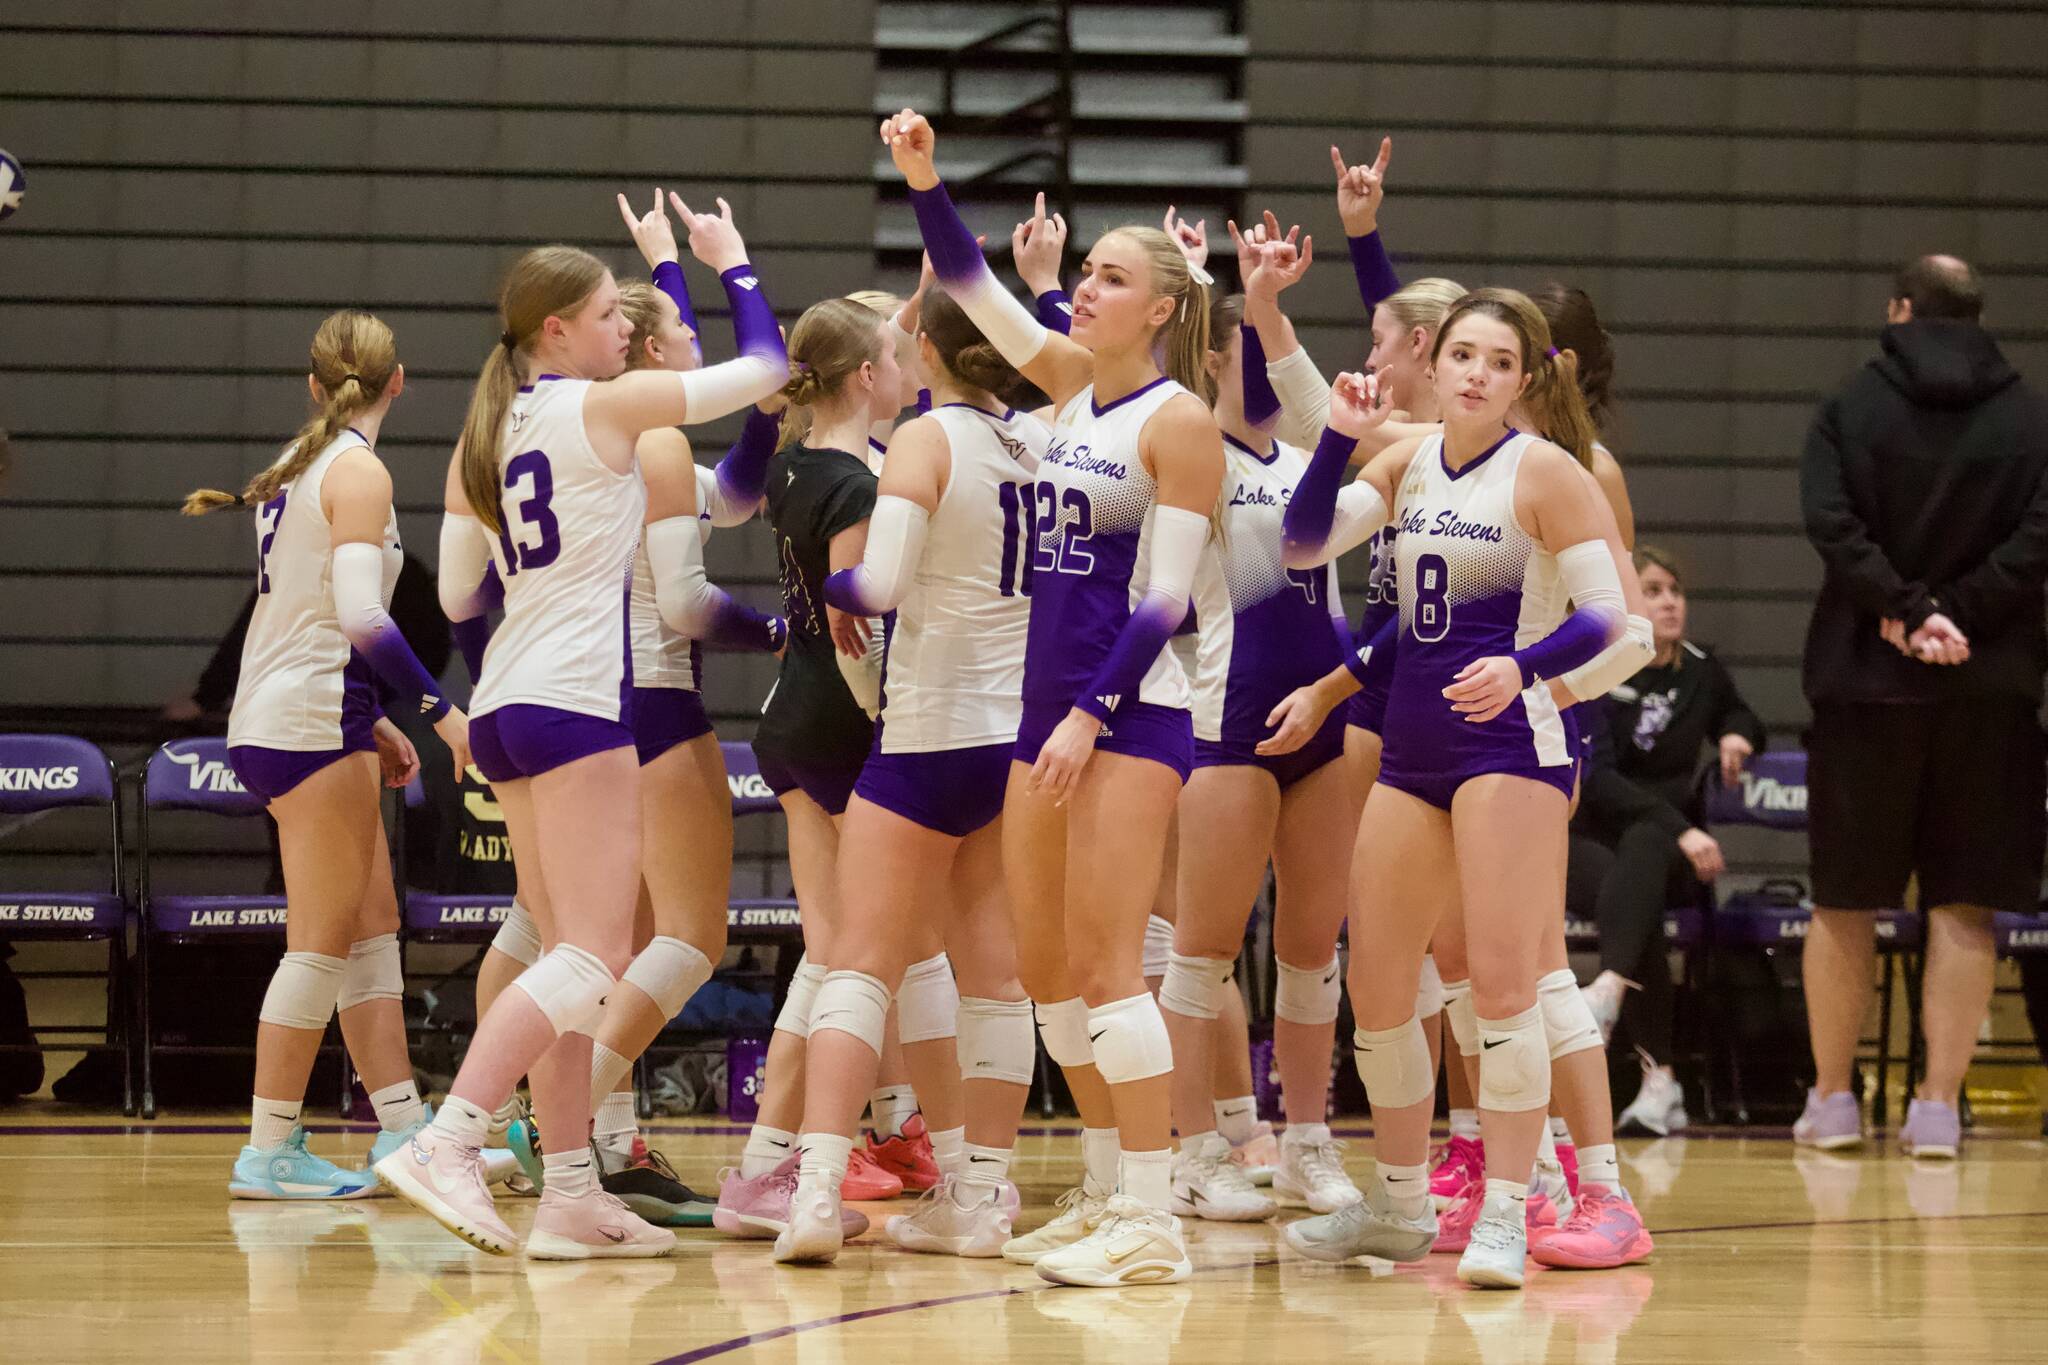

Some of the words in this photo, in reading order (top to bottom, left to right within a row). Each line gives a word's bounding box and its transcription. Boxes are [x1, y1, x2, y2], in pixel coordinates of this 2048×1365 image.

[1064, 445, 1127, 480] Stevens
[1229, 483, 1277, 506] Lake
[1034, 481, 1094, 576] 22
[1429, 510, 1503, 543] Stevens
[1412, 553, 1450, 642] 8
[22, 905, 94, 921] STEVENS
[190, 910, 235, 926] LAKE
[238, 909, 288, 925] STEVE
[440, 907, 485, 923] LAKE
